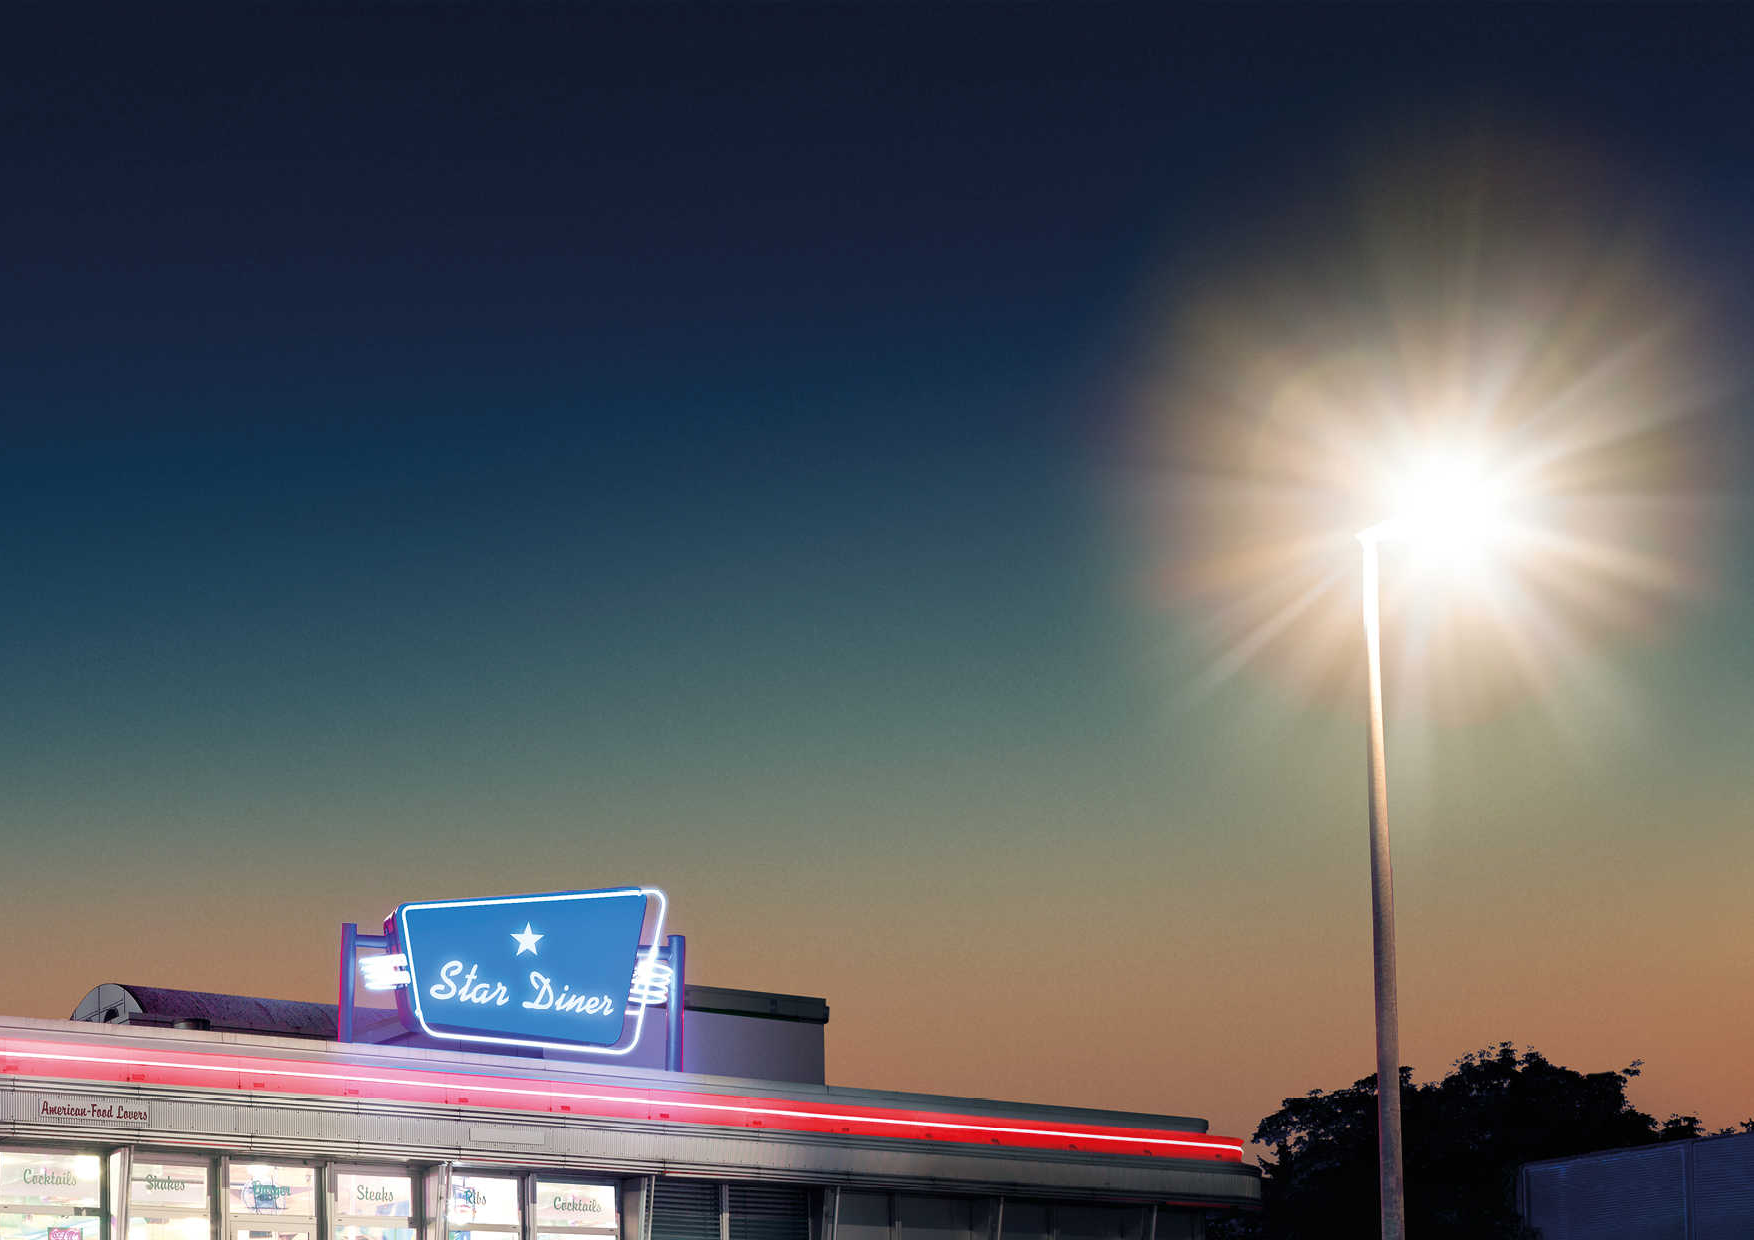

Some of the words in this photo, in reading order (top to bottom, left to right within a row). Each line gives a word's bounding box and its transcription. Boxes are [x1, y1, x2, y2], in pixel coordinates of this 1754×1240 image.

[429, 960, 510, 1006] Star
[522, 971, 614, 1016] Diner
[40, 1100, 114, 1118] American-Food
[116, 1105, 148, 1121] Lovers
[23, 1168, 78, 1186] Cocktails
[145, 1174, 186, 1191] Shakes
[356, 1184, 394, 1202] Steaks
[463, 1189, 487, 1206] Ribs
[553, 1196, 603, 1213] Cocktails
